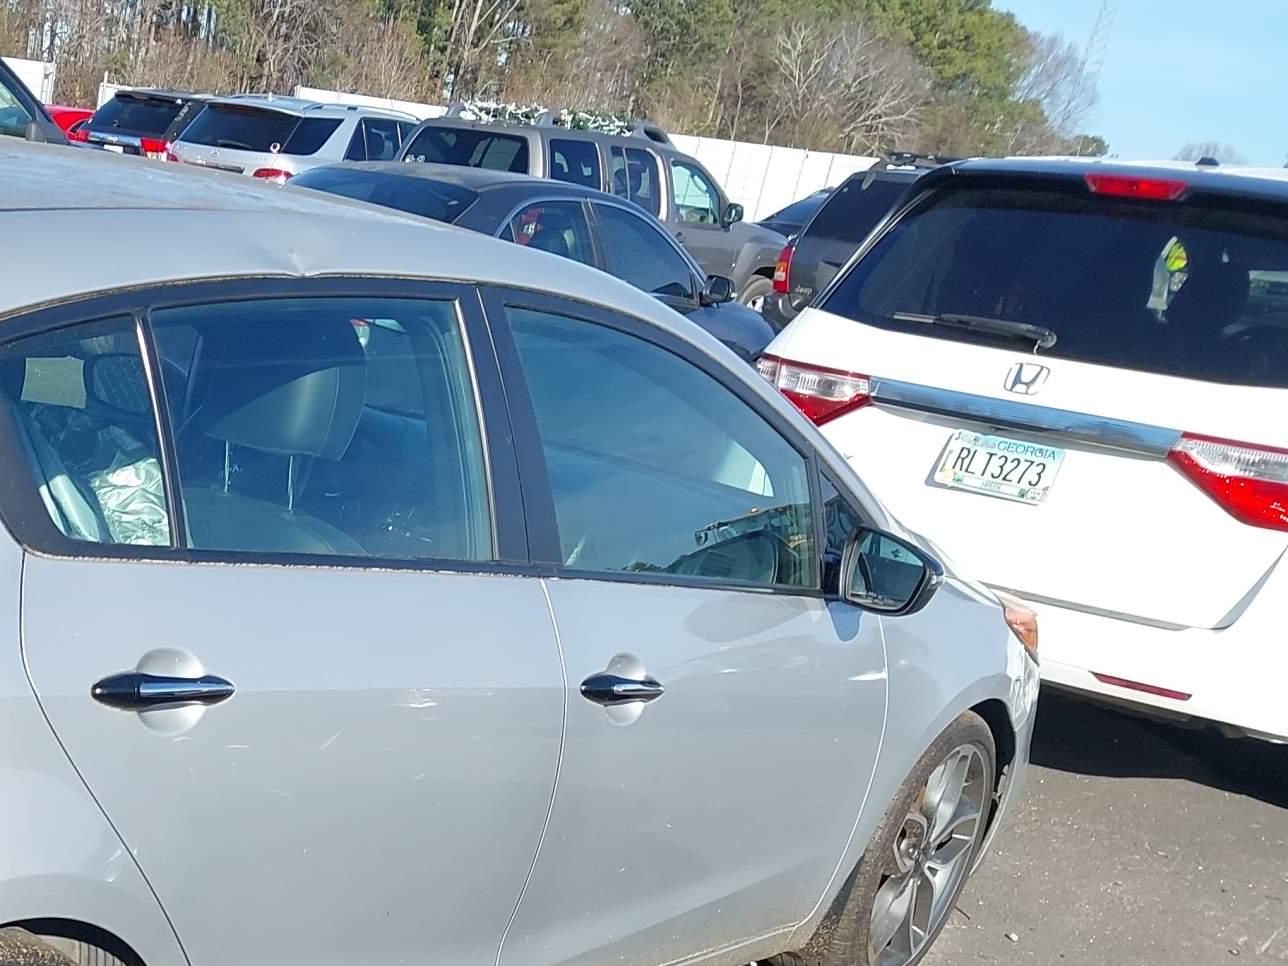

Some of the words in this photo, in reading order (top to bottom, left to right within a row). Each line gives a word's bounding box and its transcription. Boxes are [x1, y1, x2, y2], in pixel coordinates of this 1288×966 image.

[794, 284, 813, 295] Jeep
[997, 440, 1057, 461] GEORGIA
[952, 446, 1047, 487] RLT3273
